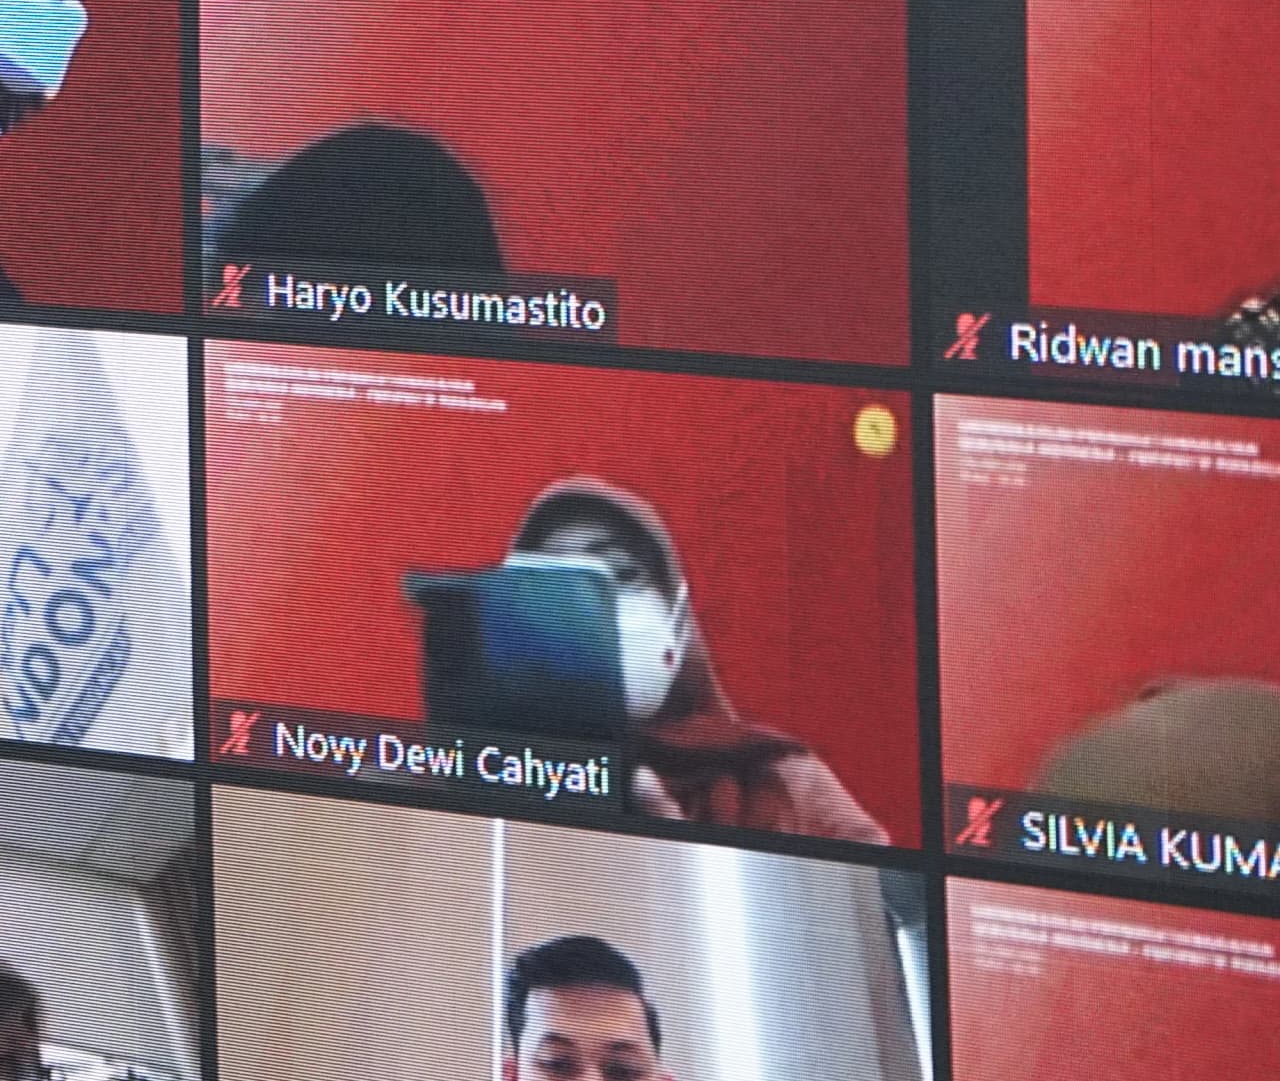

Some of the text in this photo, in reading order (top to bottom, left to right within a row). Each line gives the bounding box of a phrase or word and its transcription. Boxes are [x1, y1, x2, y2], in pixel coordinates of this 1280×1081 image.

[267, 273, 607, 331] Haryo Kusumastito
[1010, 322, 1162, 372] Ridwan
[275, 722, 611, 802] Novy Dewi Cahyati
[1022, 810, 1148, 865] SILVIA
